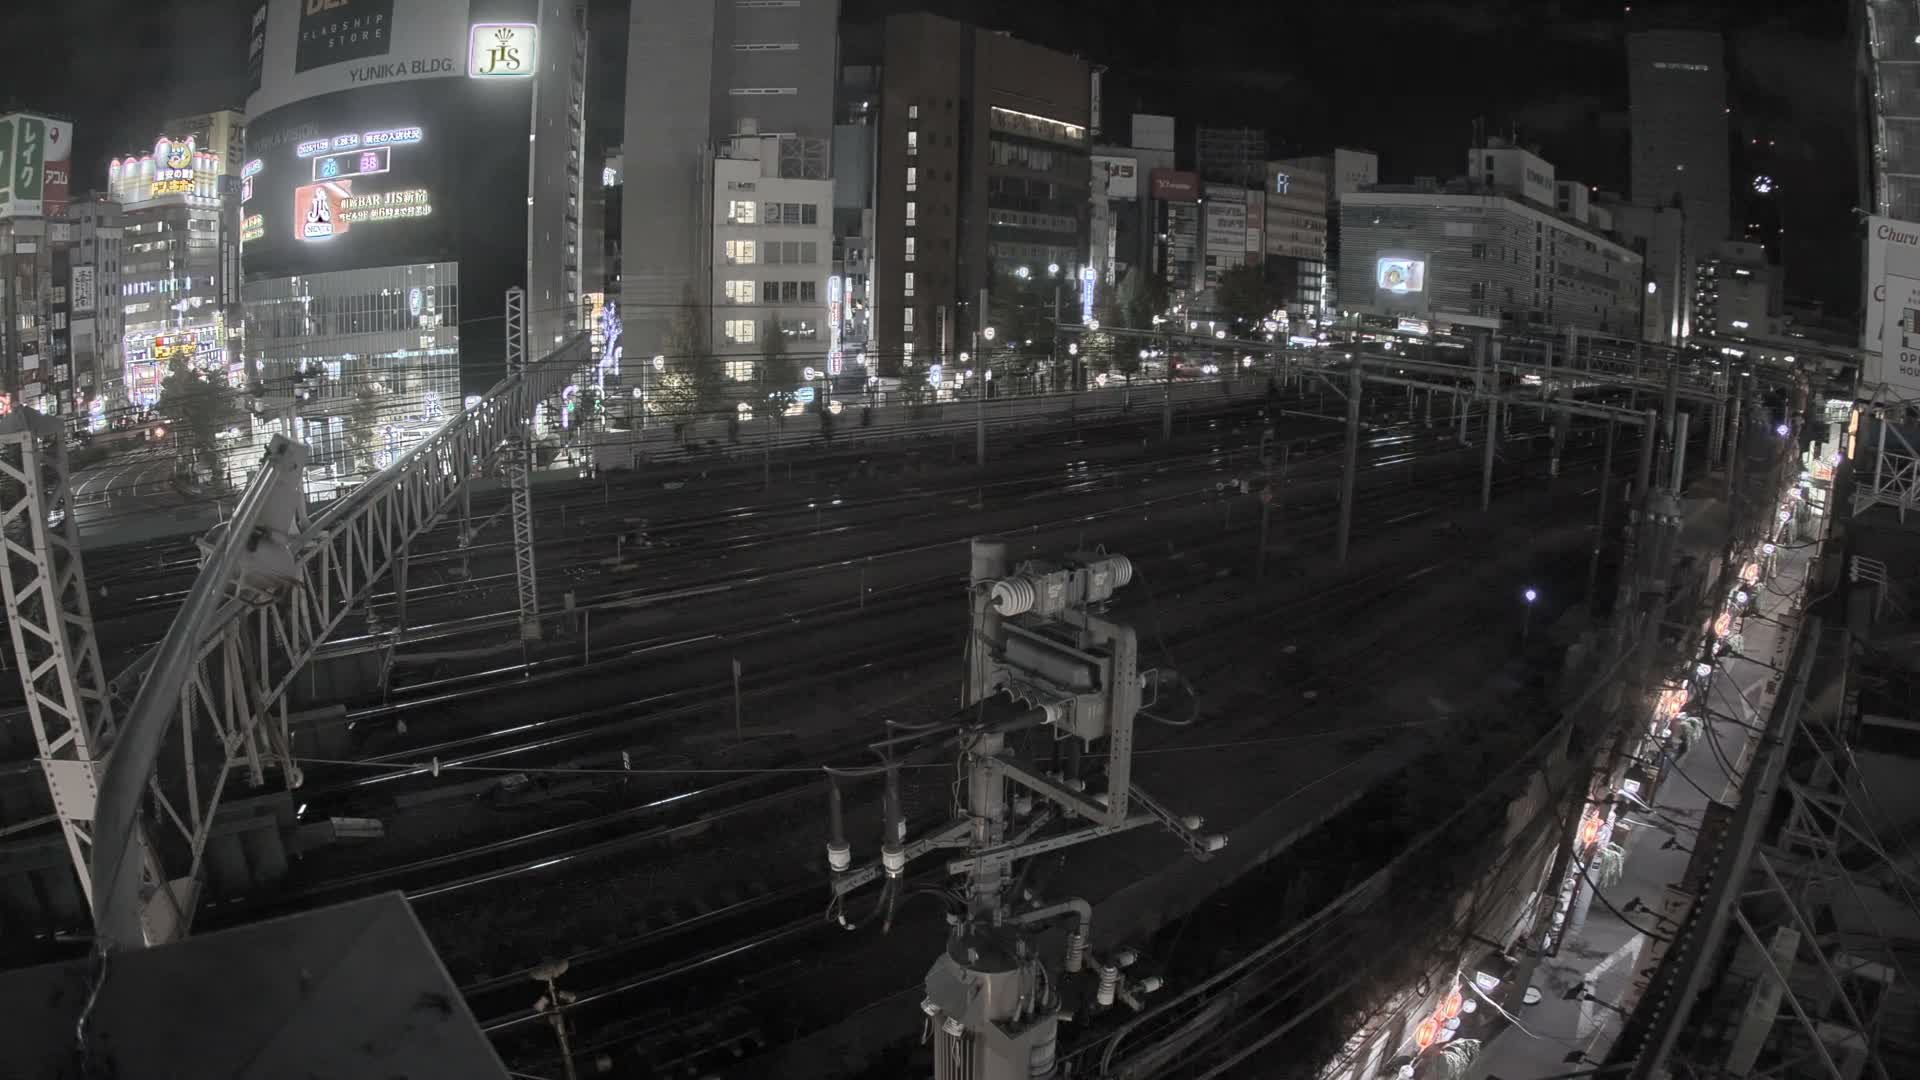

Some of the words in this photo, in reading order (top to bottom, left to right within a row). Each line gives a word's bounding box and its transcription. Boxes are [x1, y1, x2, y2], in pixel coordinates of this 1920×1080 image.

[303, 14, 384, 41] FLAGSHIP
[328, 27, 383, 48] STORE
[350, 61, 408, 83] YUNIKA
[411, 57, 456, 75] BLDG.
[21, 121, 37, 189] レイク
[45, 169, 68, 185] アコム
